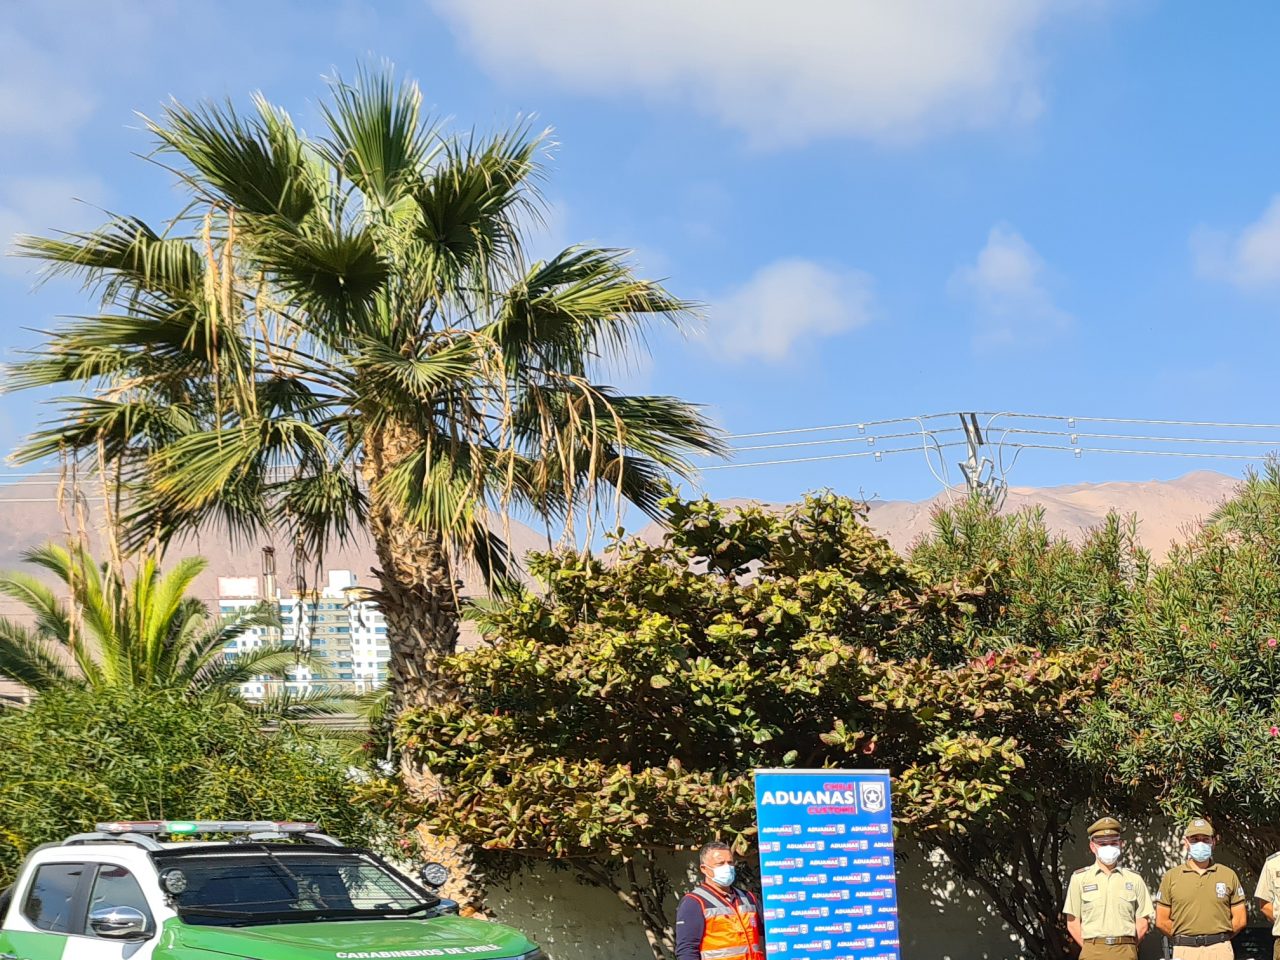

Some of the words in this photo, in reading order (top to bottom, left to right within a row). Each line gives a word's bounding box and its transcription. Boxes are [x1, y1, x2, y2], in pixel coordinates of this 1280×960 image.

[761, 791, 854, 805] ADUANAS
[336, 949, 444, 959] CARABINEROS
[464, 944, 502, 953] CHILE
